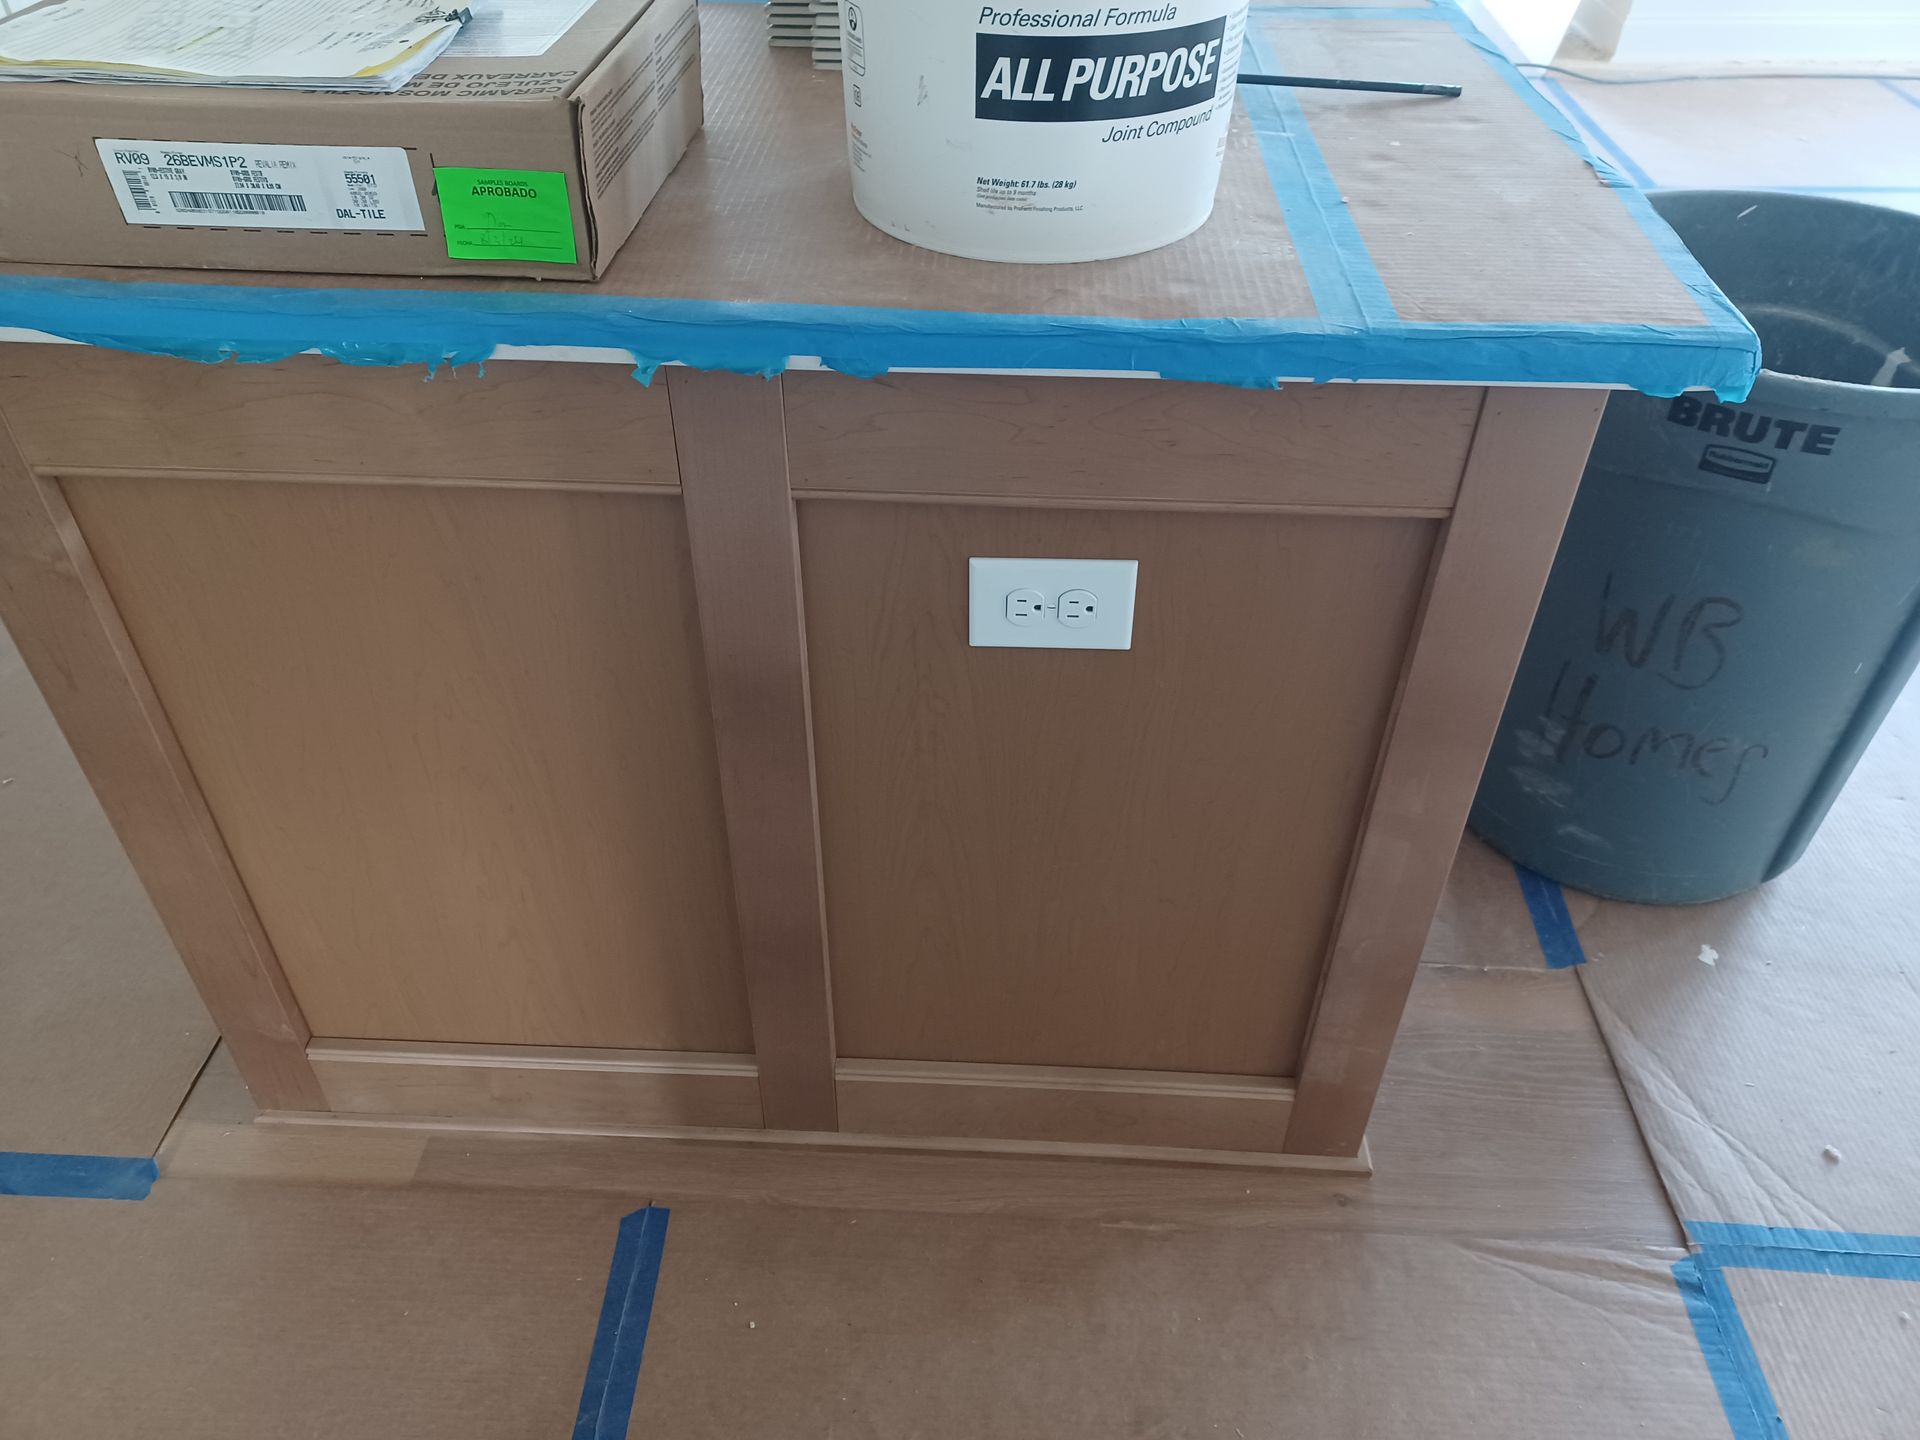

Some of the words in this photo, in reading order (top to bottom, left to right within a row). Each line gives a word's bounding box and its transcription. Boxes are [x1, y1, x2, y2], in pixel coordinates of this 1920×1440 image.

[978, 6, 1101, 28] Professional
[1104, 3, 1177, 27] Formula
[455, 70, 578, 80] CARREAUX
[980, 56, 1054, 102] ALL
[1061, 38, 1221, 102] PURPOSE
[466, 78, 571, 88] AZULEJO
[456, 86, 562, 97] CERAMIC
[1101, 124, 1144, 143] Joint
[1146, 106, 1214, 138] Compound
[114, 152, 150, 165] RV09
[163, 153, 247, 168] 26BEVMS1P2
[345, 173, 376, 185] 55501
[976, 176, 990, 185] Net
[991, 178, 1020, 189] Weight:
[1020, 180, 1037, 188] 61.7
[1037, 180, 1051, 189] lbs.
[1051, 180, 1064, 189] (28
[1064, 180, 1077, 190] kg)
[471, 186, 537, 199] APROBADO
[336, 208, 386, 219] DAL-TILE
[1667, 395, 1841, 456] BRUTE
[1593, 571, 1743, 690] WB
